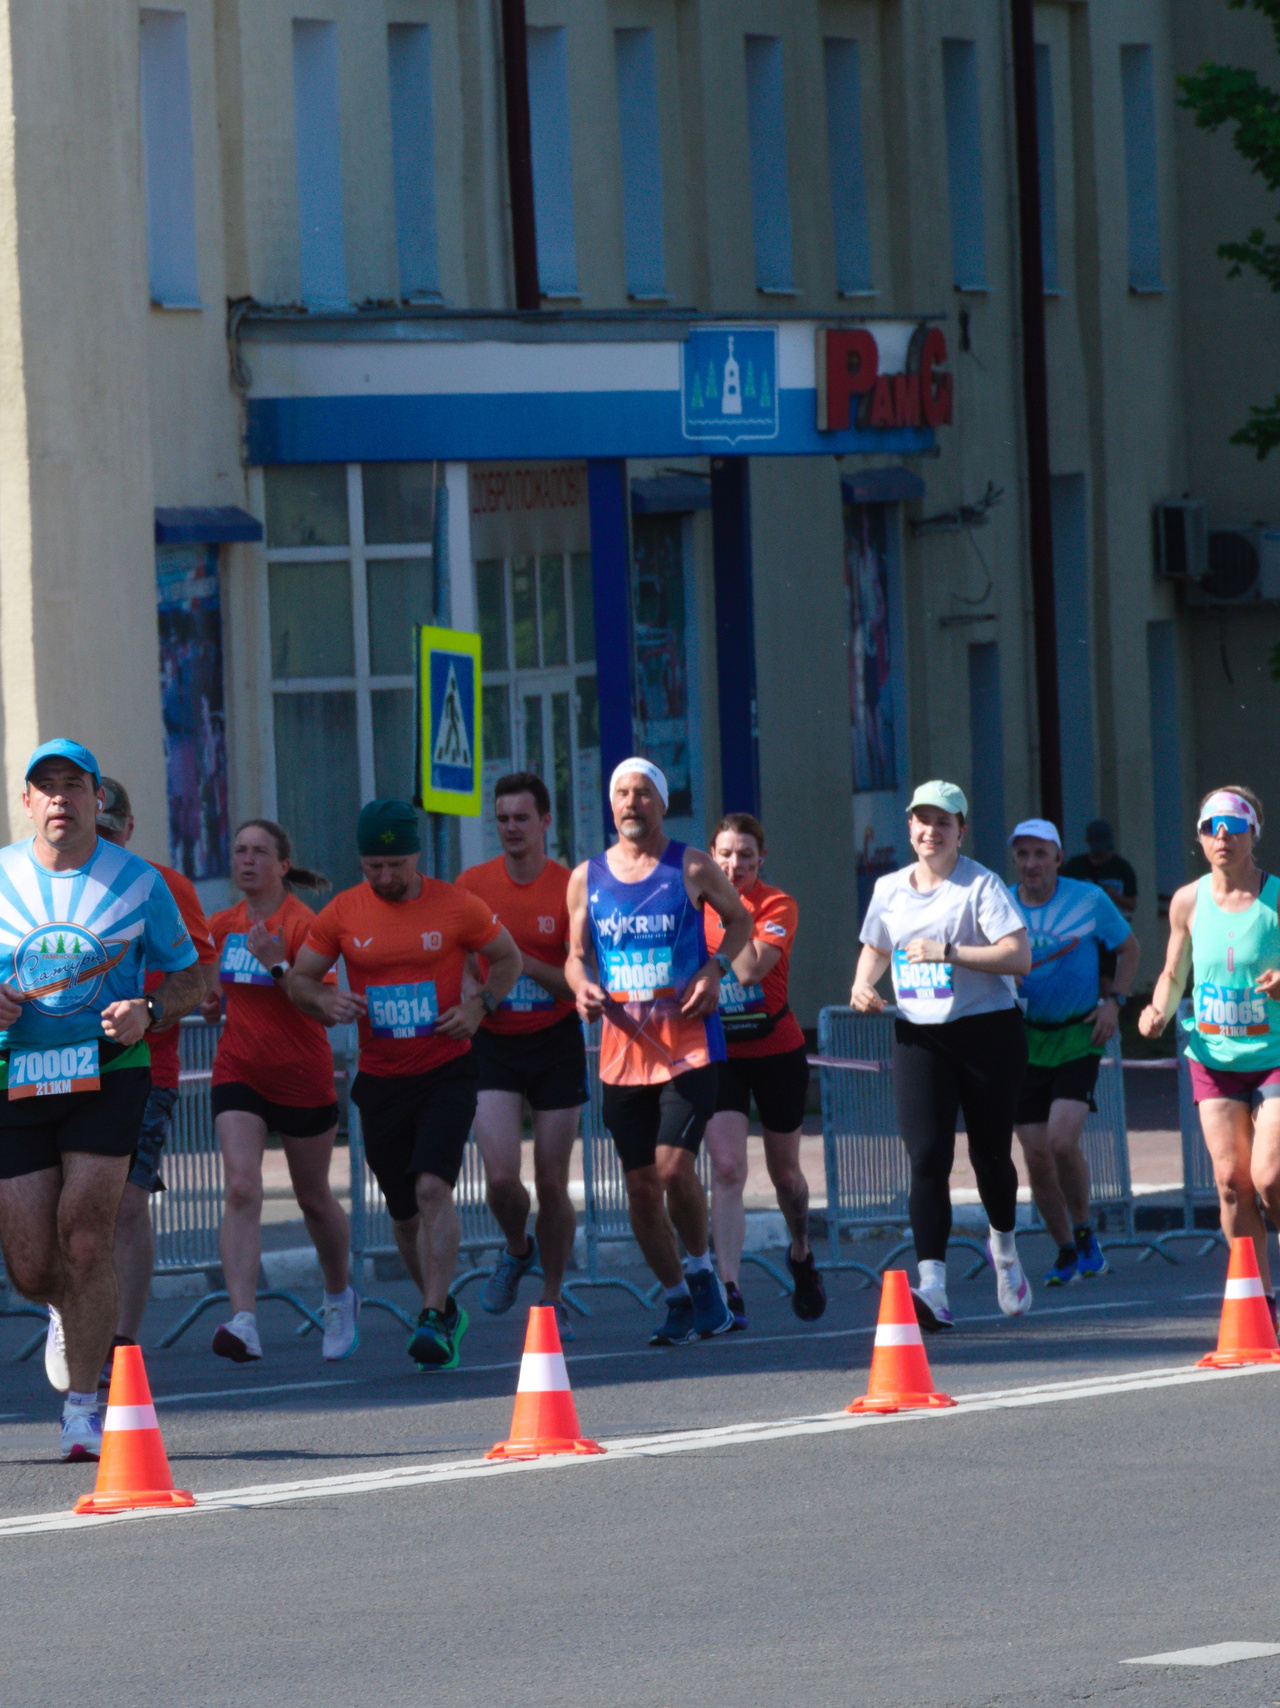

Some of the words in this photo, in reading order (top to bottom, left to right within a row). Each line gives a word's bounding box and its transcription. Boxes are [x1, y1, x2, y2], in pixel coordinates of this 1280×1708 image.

[610, 962, 670, 990] 70068
[900, 963, 949, 988] 50214
[373, 997, 433, 1026] 50314
[1203, 996, 1265, 1025] 70065
[392, 1026, 416, 1039] 10KM
[14, 1046, 94, 1084] 70002
[36, 1079, 71, 1096] 21.1KM
